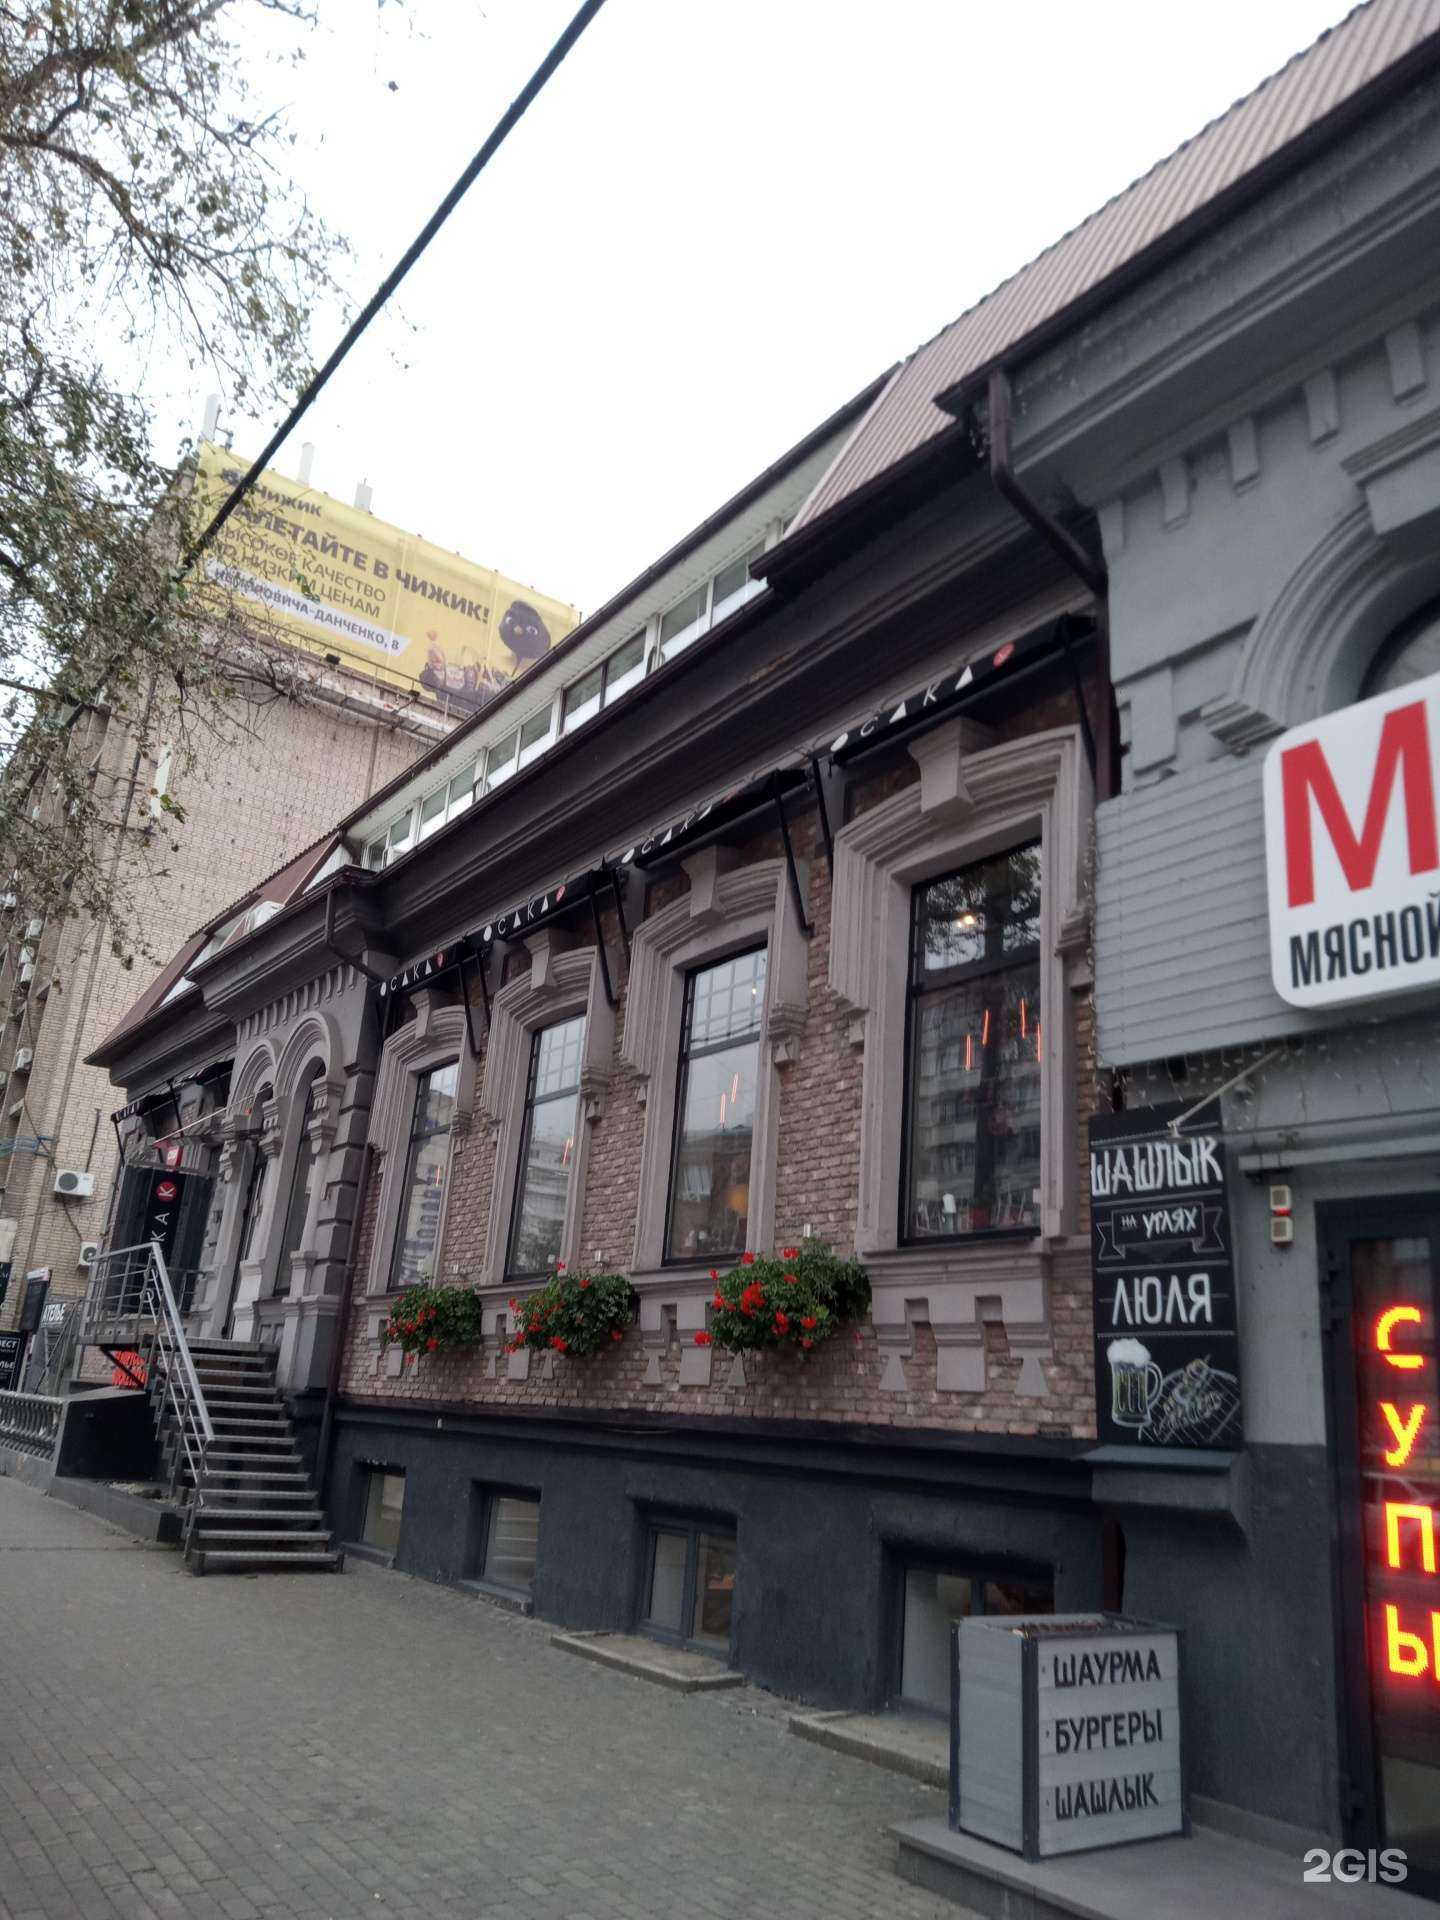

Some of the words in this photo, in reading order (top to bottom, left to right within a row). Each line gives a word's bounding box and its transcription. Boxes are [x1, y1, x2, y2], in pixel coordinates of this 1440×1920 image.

[302, 556, 387, 602] КАЧЕСТВО
[320, 584, 381, 619] ЦЕНАМ
[373, 558, 389, 581] В
[396, 568, 490, 625] ЧИЖИК!
[391, 638, 400, 651] 8
[1090, 1135, 1224, 1197] ШАШЛЫК
[1121, 1214, 1137, 1229] НА
[1142, 1205, 1199, 1239] УГЛЯХ
[1111, 1272, 1213, 1327] ЛЮЛЯ
[1053, 1648, 1162, 1689] ШАУРМА
[1055, 1709, 1163, 1754] БУРГЕРЫ
[1055, 1772, 1159, 1820] ШАШЛЫК
